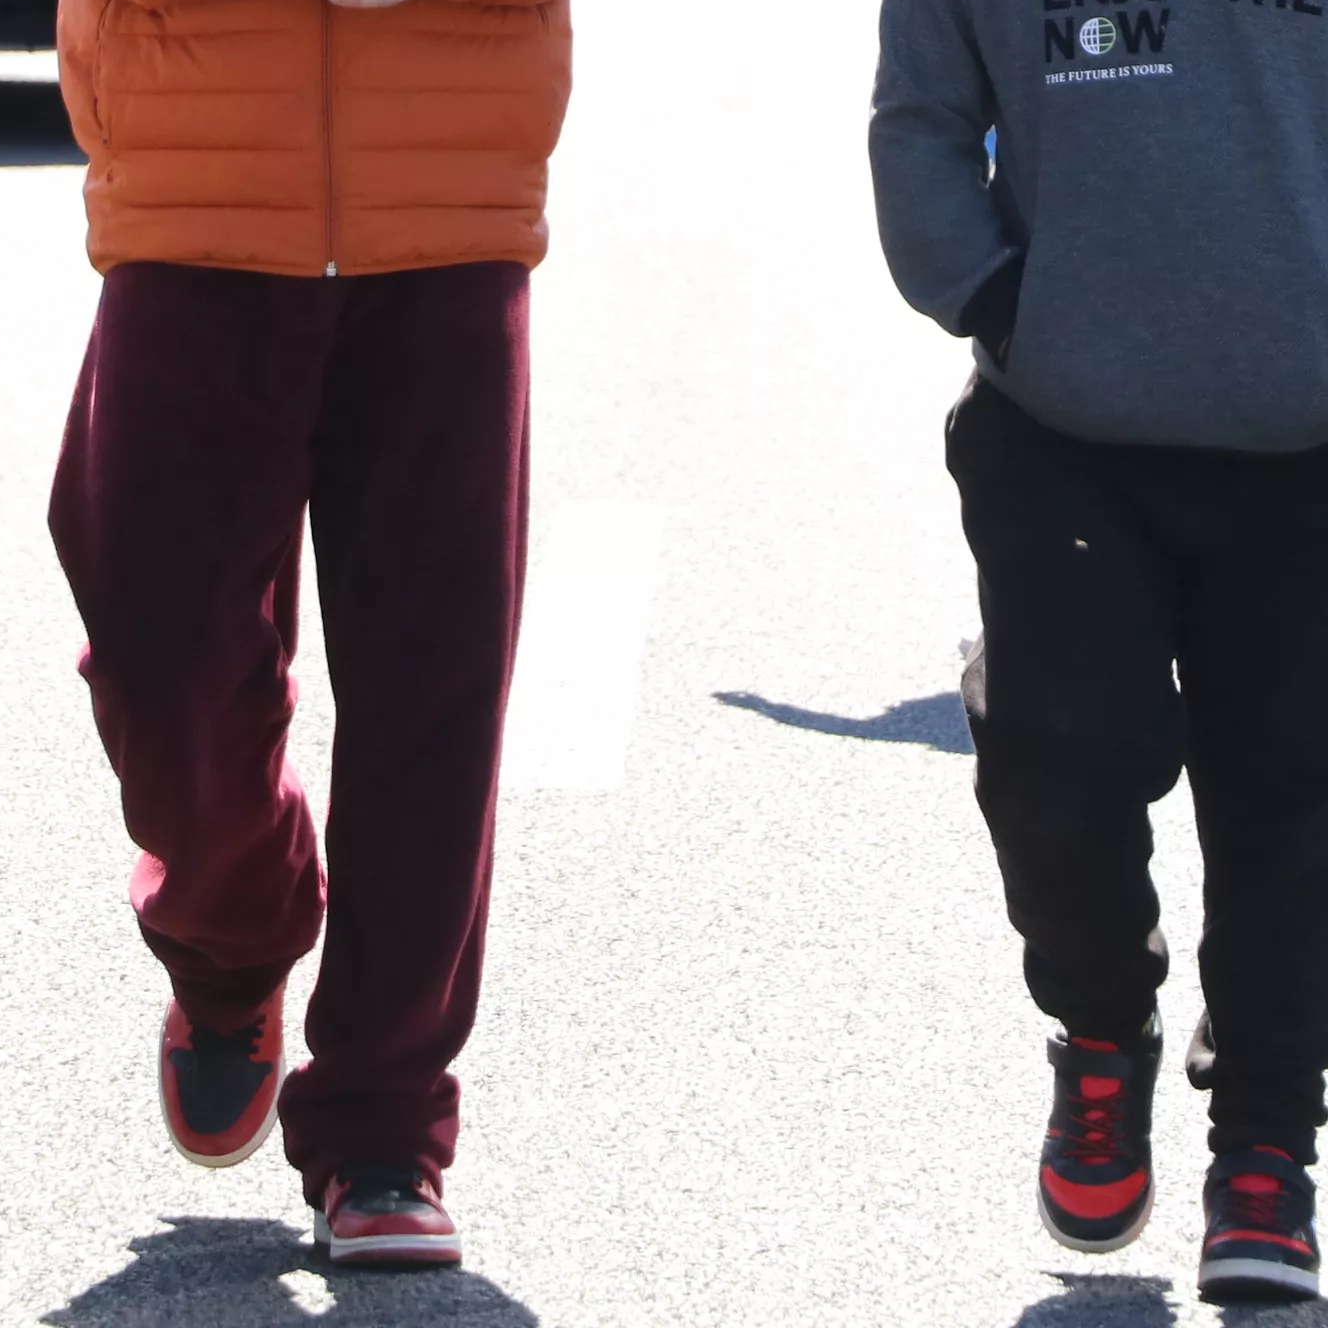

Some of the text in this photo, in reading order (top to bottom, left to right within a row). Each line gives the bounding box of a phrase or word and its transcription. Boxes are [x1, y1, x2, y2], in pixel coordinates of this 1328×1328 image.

[1045, 63, 1174, 85] THE FUTURE IS YOURS
